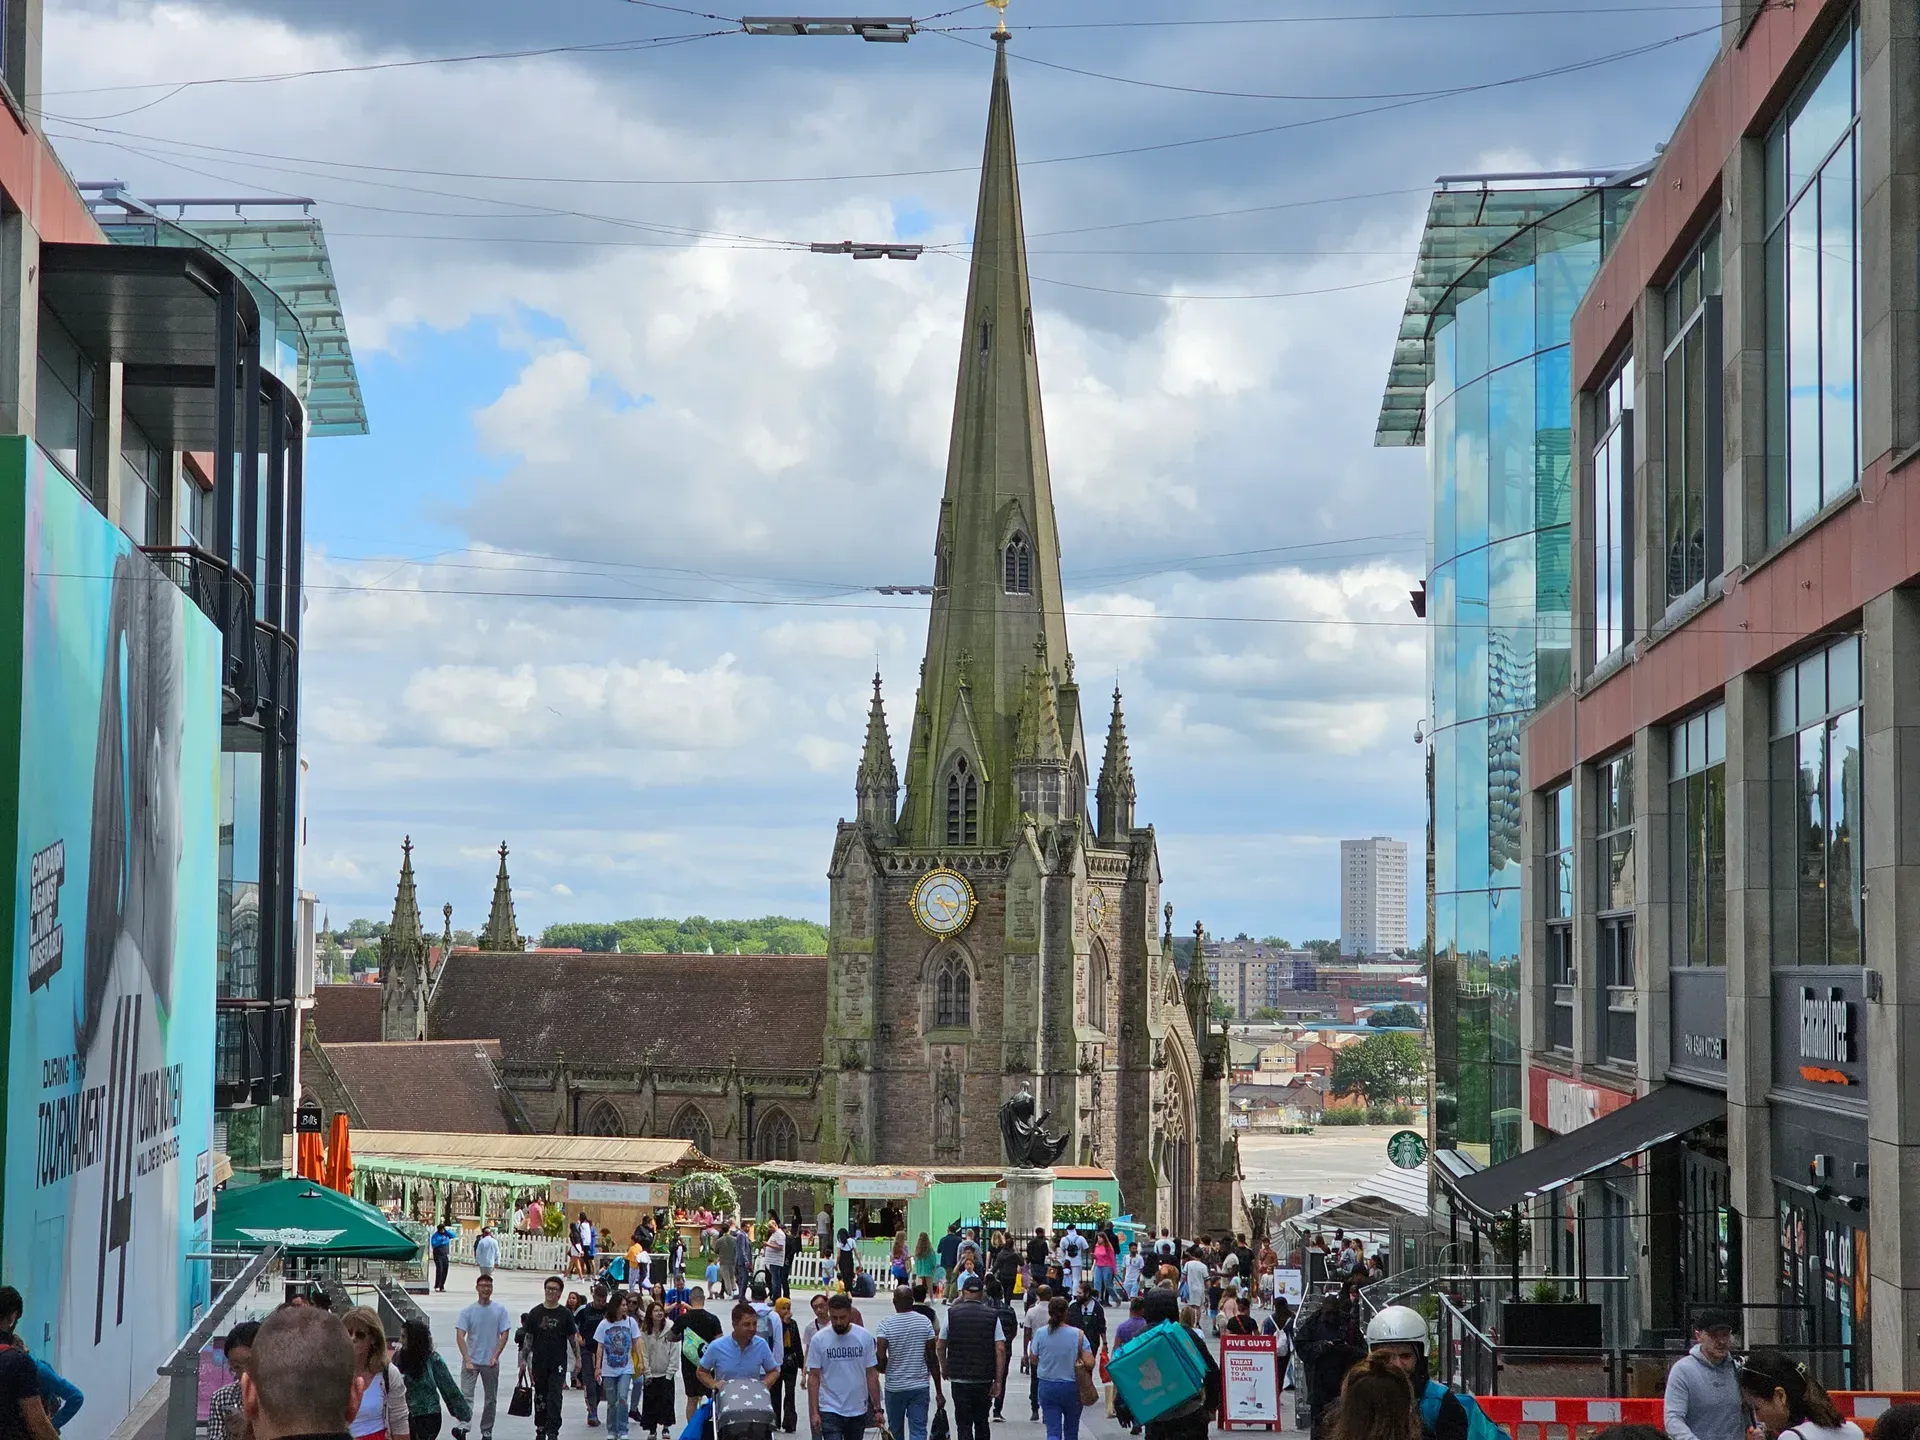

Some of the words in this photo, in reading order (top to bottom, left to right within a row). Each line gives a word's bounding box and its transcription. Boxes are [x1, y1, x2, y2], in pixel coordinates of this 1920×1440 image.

[31, 842, 64, 887] CAMPAIGN
[31, 874, 57, 917] AGAINST
[30, 905, 52, 947] LIVING
[43, 1055, 69, 1089] DURING
[72, 1053, 86, 1082] THIS
[137, 1070, 159, 1145] YOUNG
[160, 1062, 183, 1133] WOMEN
[36, 1085, 106, 1190] TOURNAMENT
[162, 1135, 179, 1165] SUICIDE
[826, 1346, 864, 1359] HOODRICH
[1226, 1339, 1246, 1347] FIVE
[1247, 1339, 1272, 1347] GUYS
